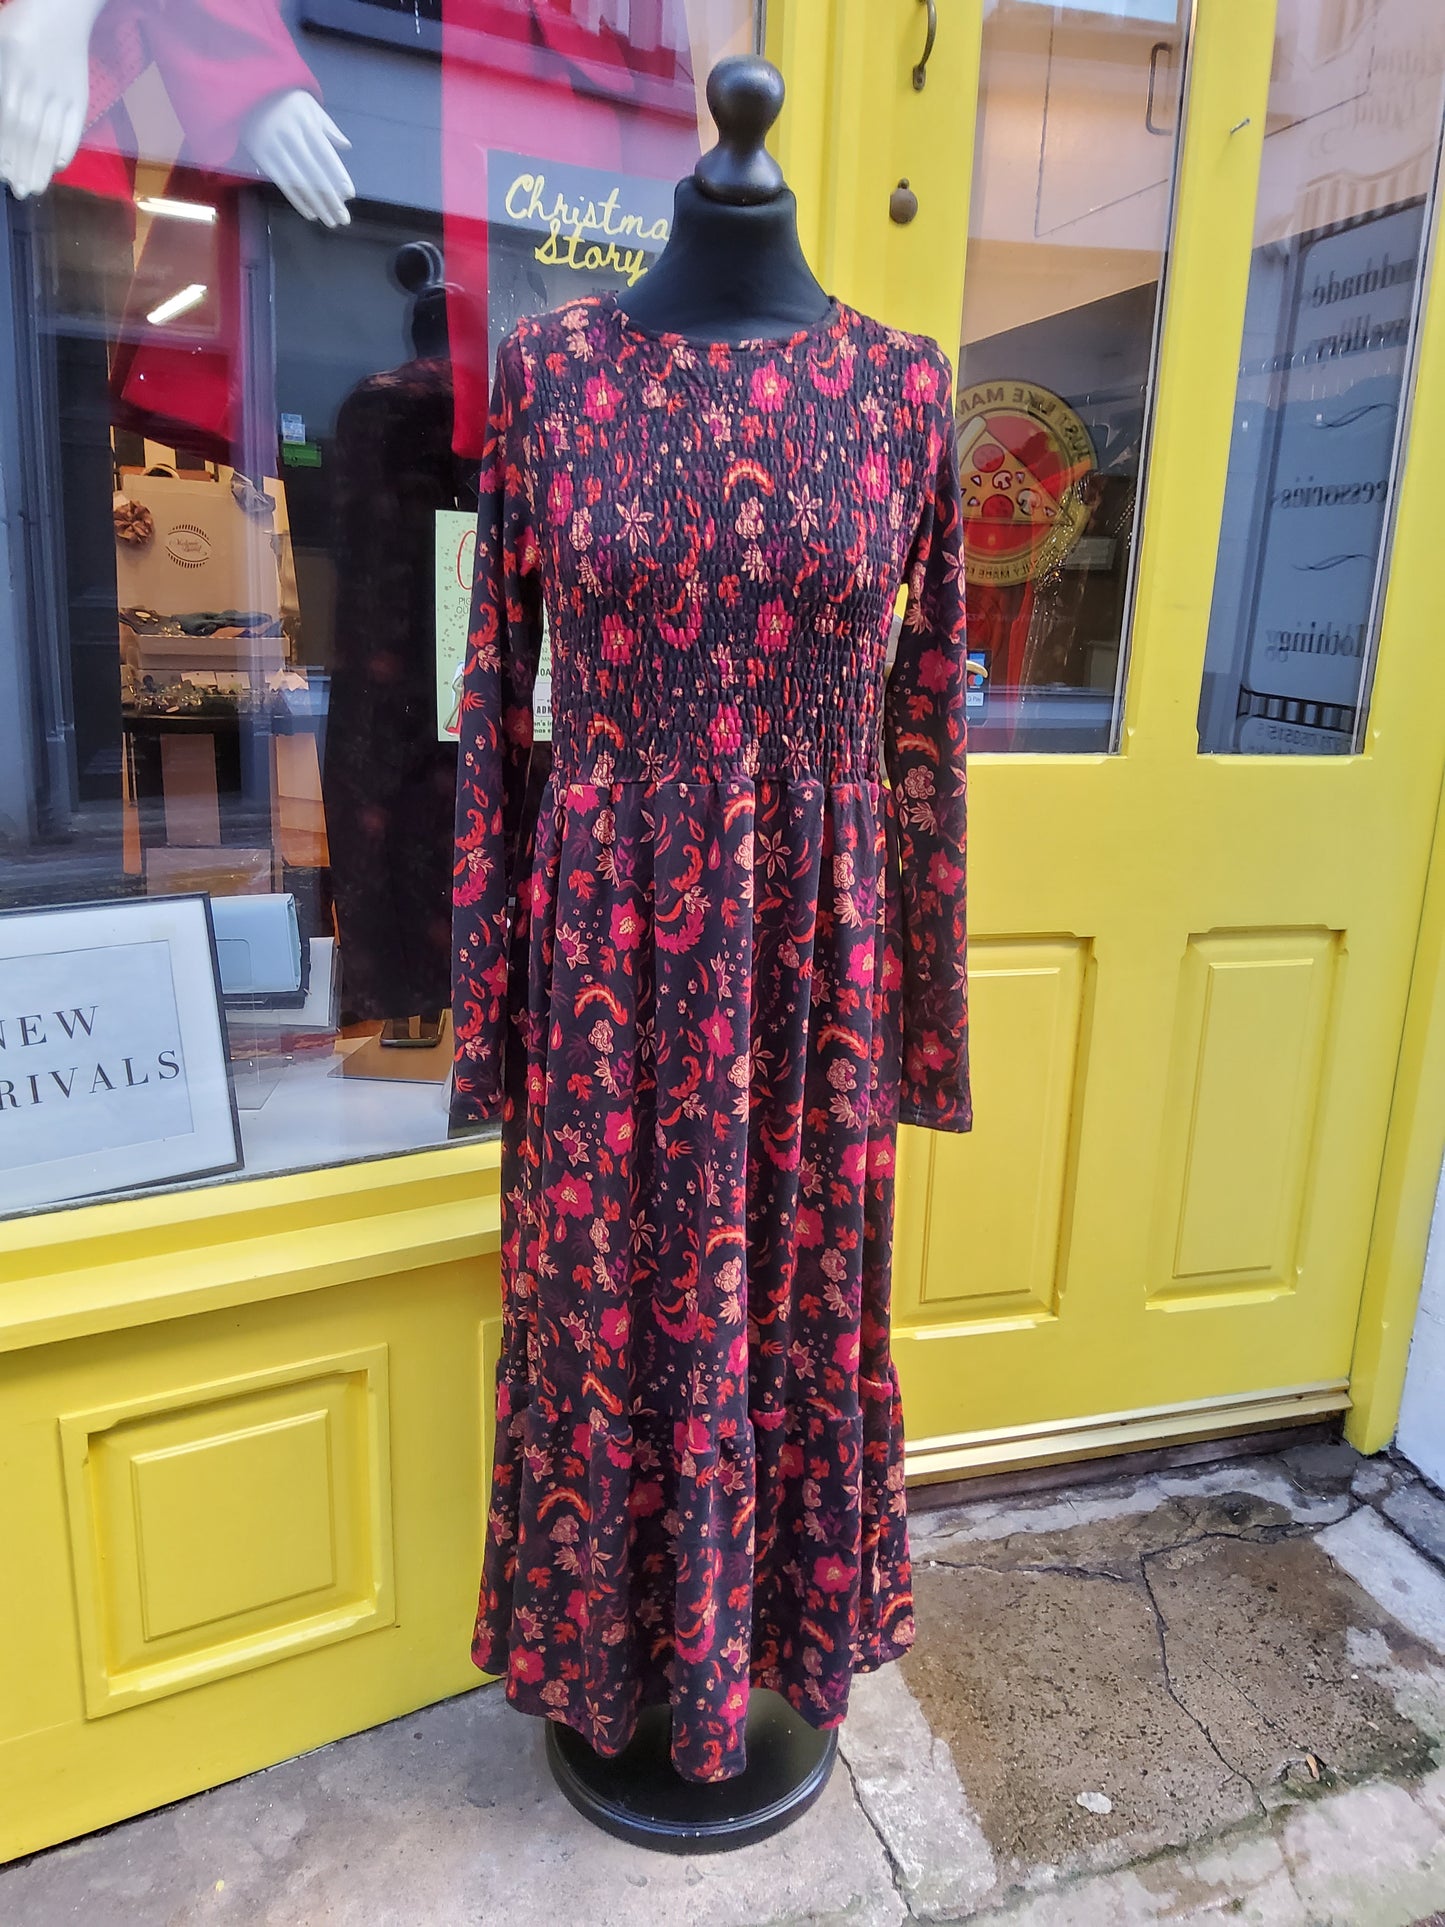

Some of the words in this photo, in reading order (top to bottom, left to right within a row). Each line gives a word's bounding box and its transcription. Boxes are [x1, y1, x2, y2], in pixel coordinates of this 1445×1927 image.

[505, 174, 669, 241] Christma
[534, 217, 649, 287] Story
[0, 1005, 99, 1050] EW
